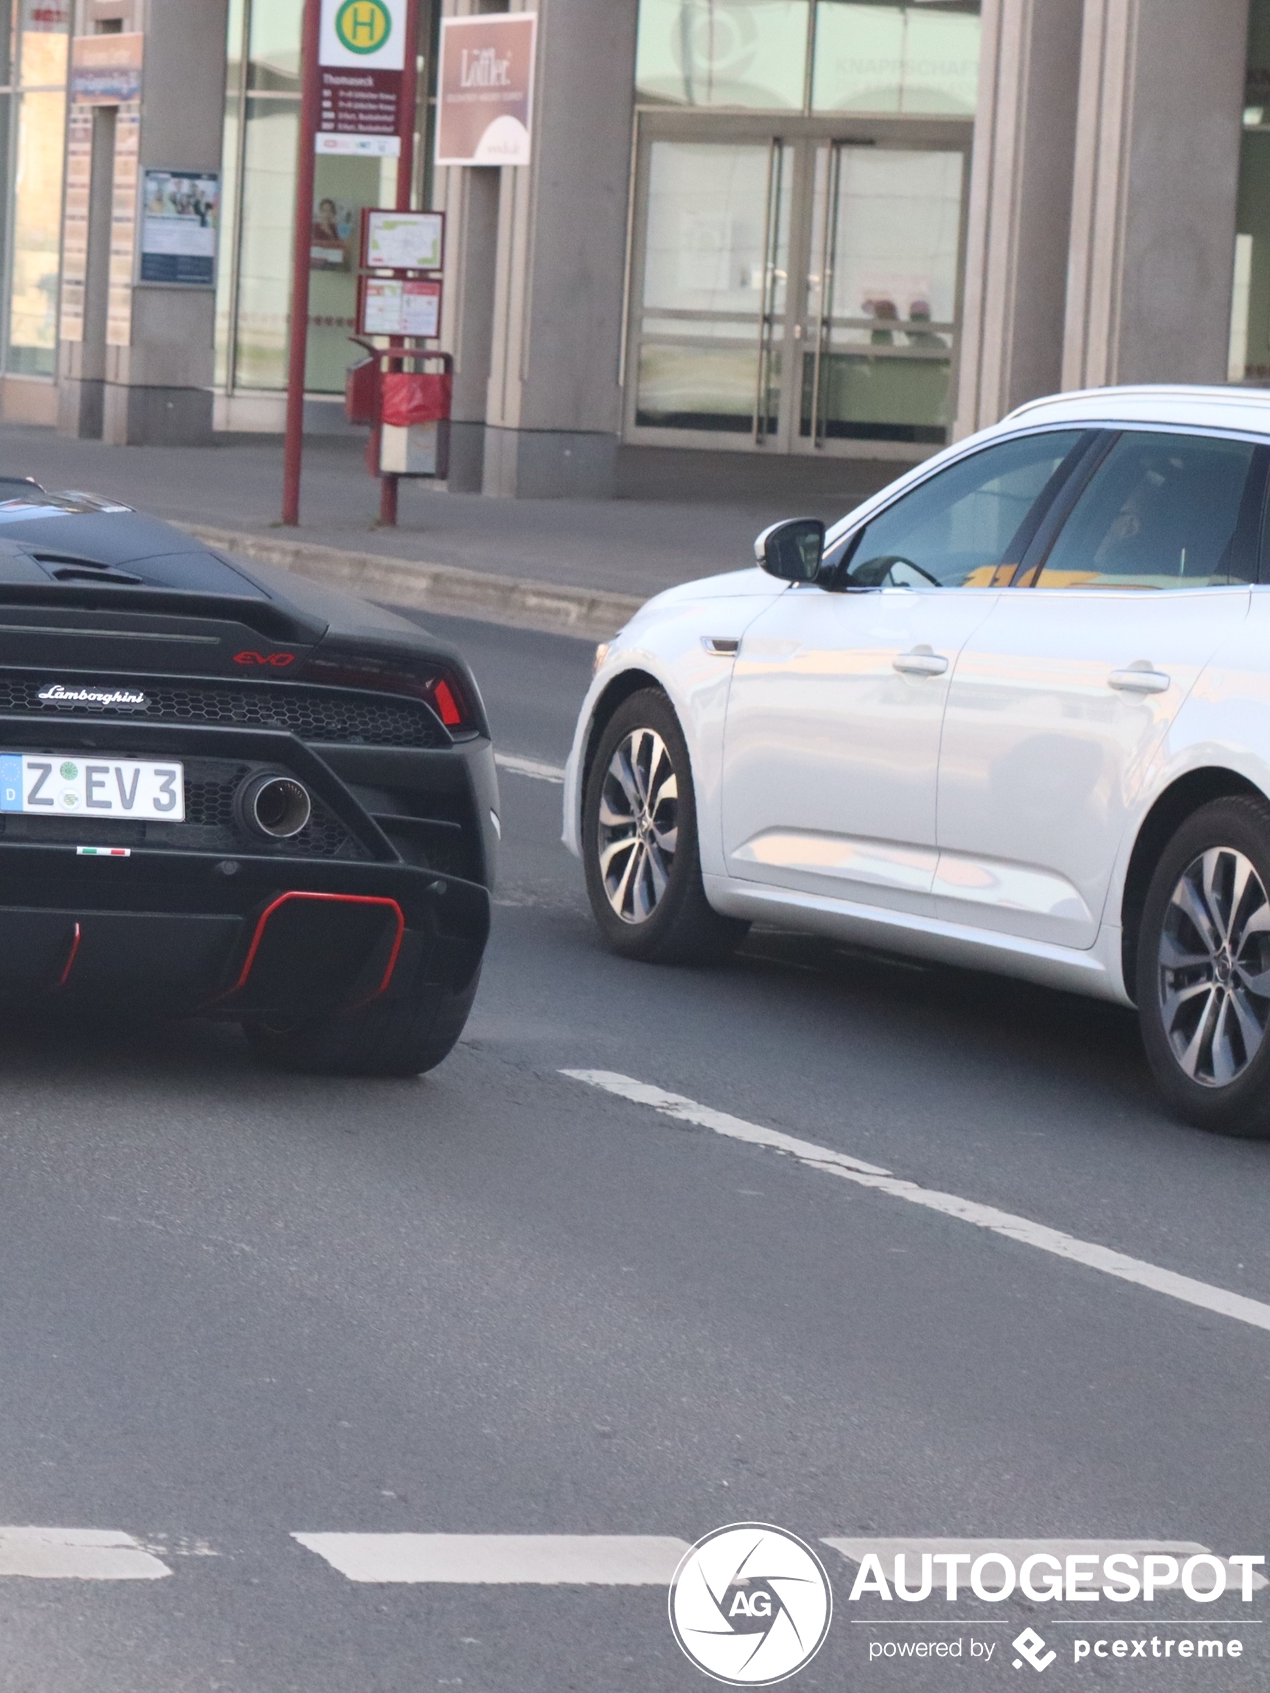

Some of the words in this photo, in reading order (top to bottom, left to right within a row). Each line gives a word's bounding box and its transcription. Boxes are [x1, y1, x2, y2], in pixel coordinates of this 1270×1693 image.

[351, 6, 376, 41] H
[38, 684, 145, 705] Lamborghini
[6, 788, 16, 801] D
[27, 762, 54, 806] Z
[85, 765, 141, 810] EV
[152, 769, 177, 812] 3
